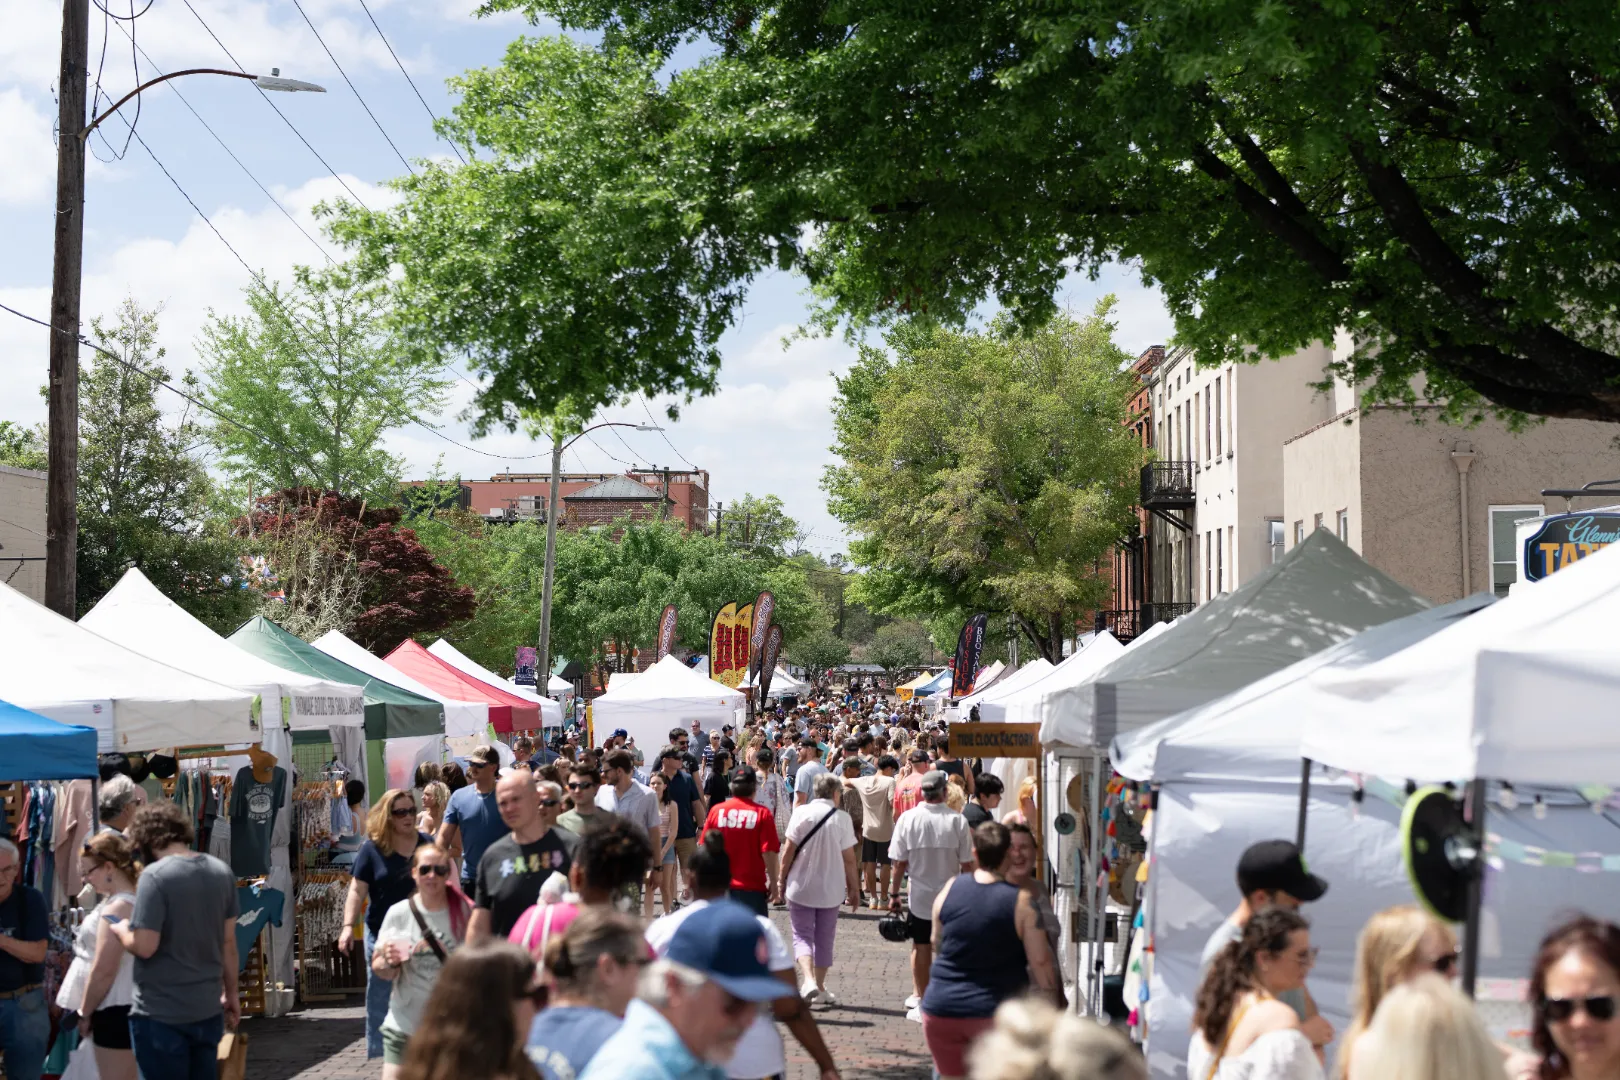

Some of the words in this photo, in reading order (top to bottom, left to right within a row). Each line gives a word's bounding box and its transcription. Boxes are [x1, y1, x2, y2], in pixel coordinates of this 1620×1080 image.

[1540, 543, 1609, 576] TA
[714, 622, 725, 674] Skeeter
[724, 626, 733, 670] Beater
[975, 733, 1000, 746] CLOCK
[1000, 733, 1034, 746] FACTORY
